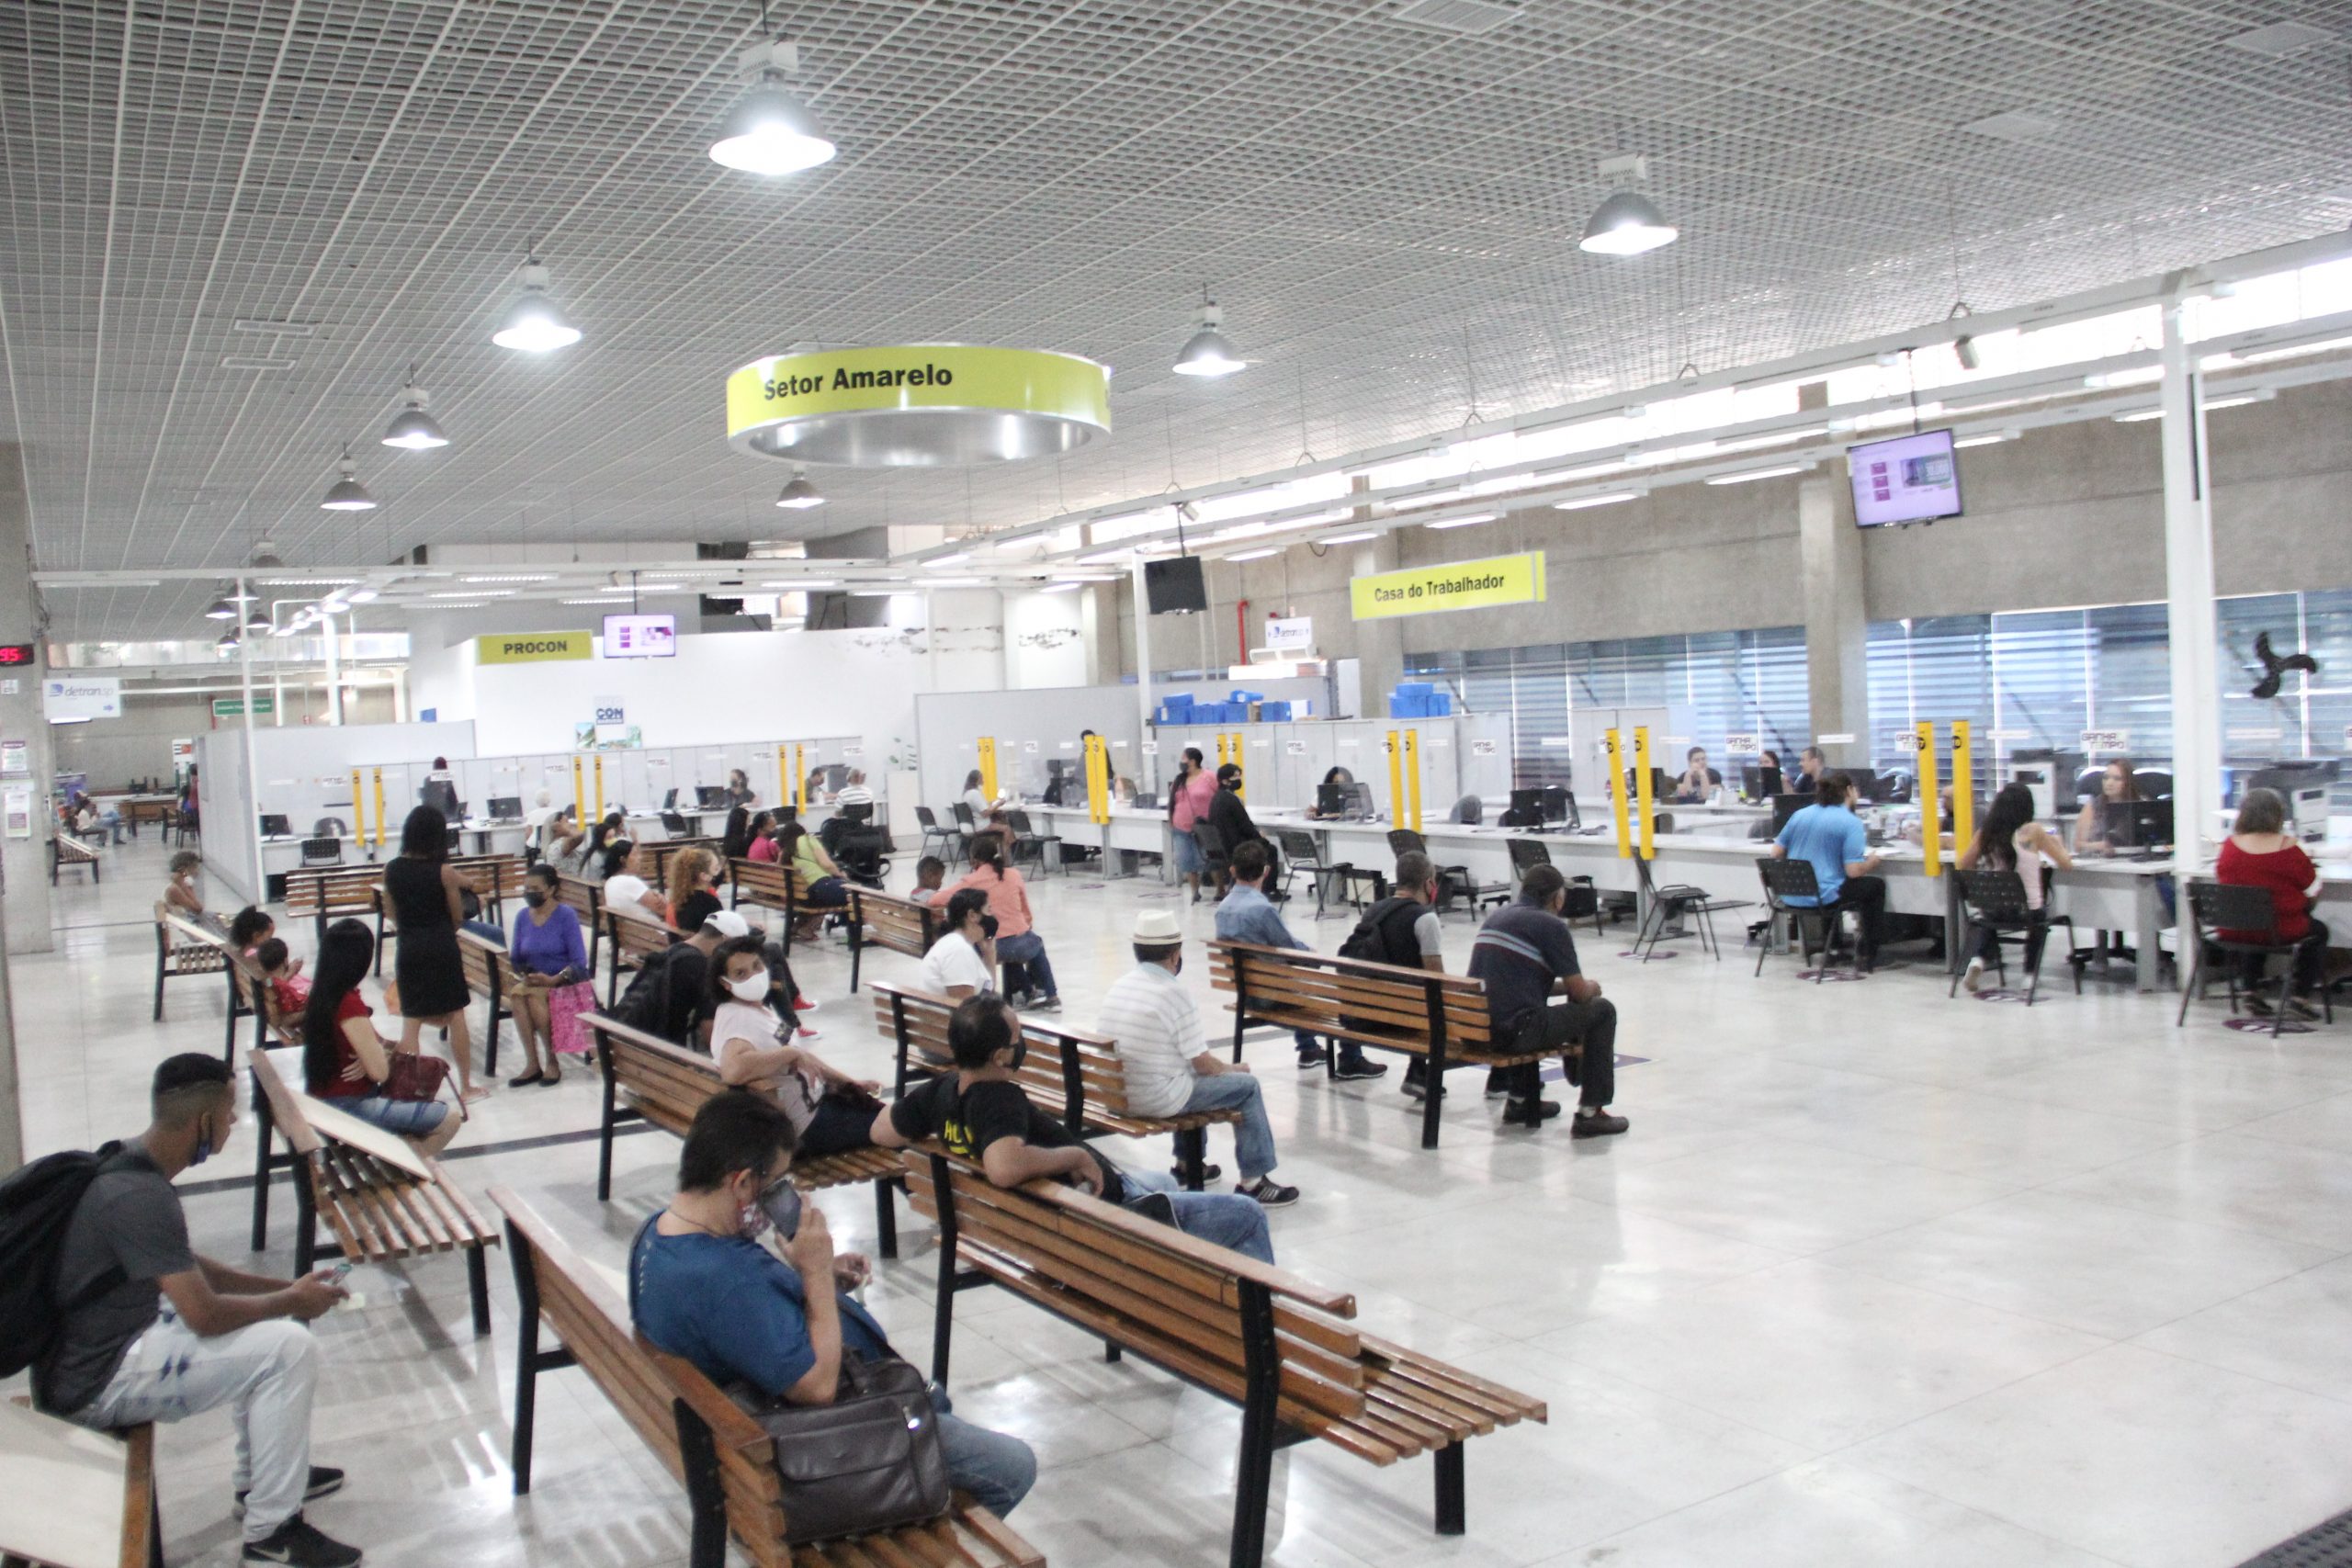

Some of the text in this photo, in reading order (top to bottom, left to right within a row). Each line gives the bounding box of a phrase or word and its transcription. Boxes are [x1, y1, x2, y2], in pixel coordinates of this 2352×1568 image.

[764, 364, 952, 400] Setor Amarelo
[1374, 574, 1505, 603] Casa do Trabalhador
[503, 640, 568, 655] PROCON
